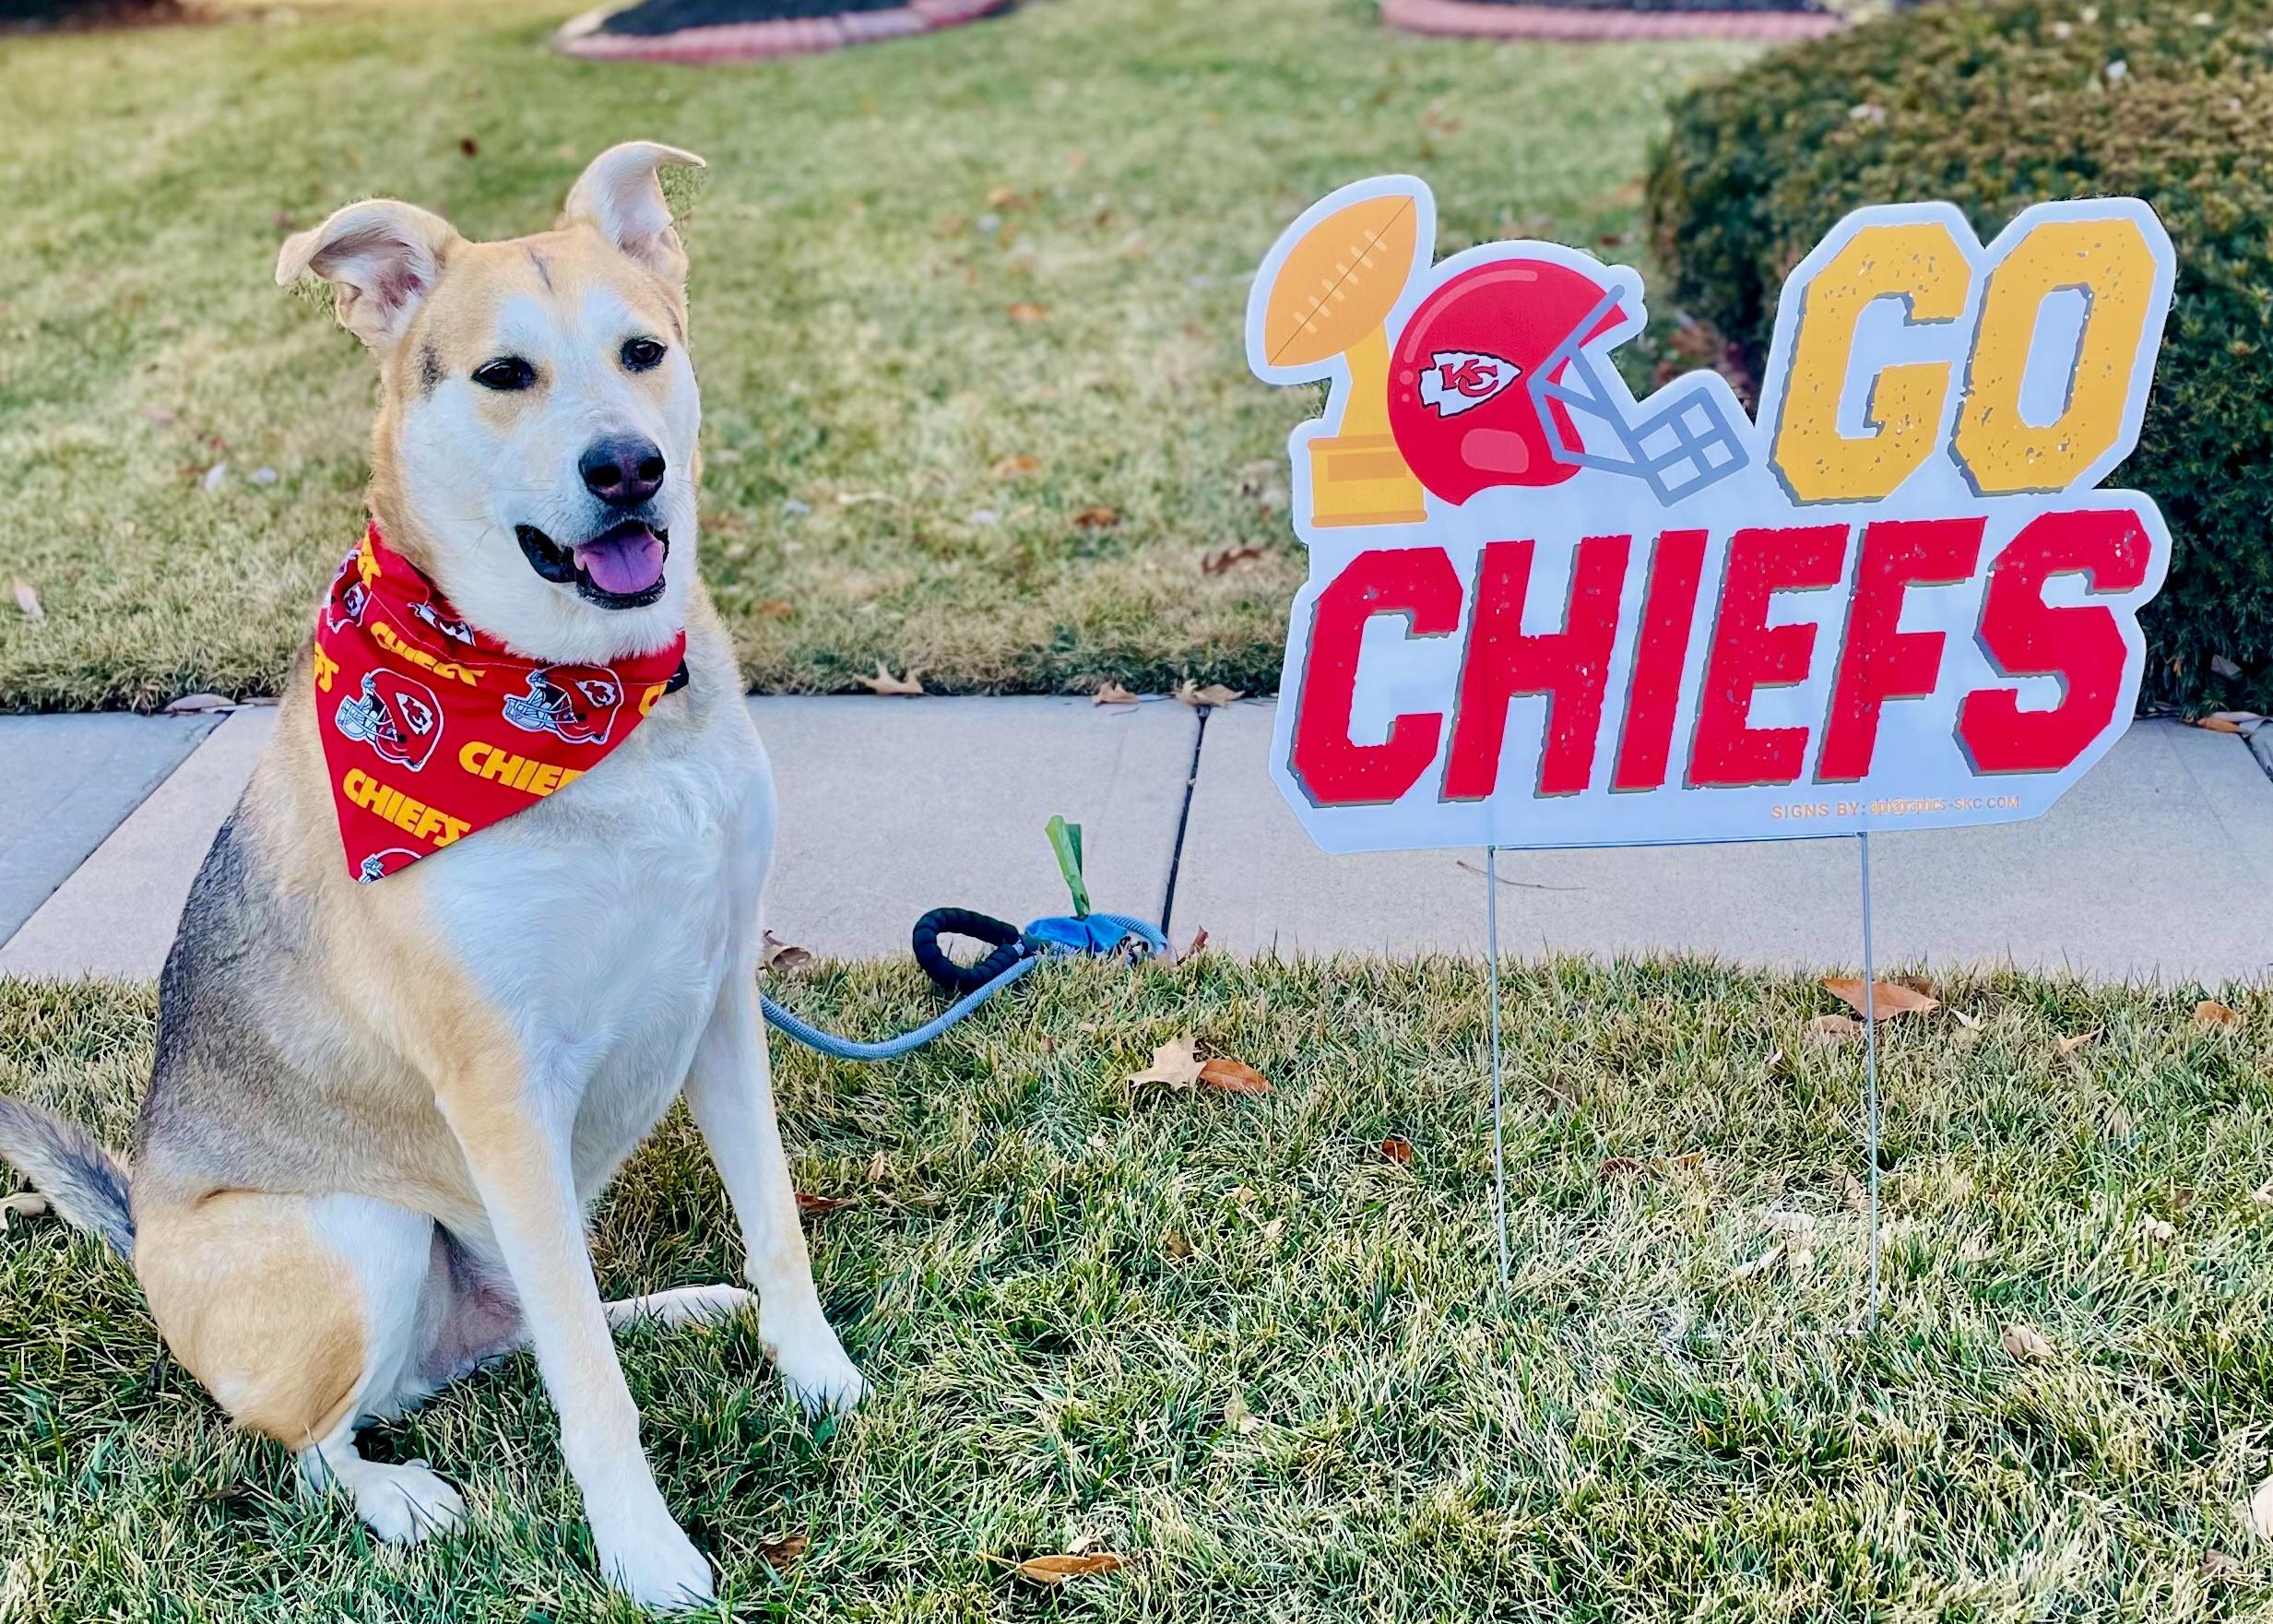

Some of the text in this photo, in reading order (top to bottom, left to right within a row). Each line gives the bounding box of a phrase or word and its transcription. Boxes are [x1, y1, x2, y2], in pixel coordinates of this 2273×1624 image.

[1438, 359, 1498, 397] KC
[1770, 221, 2154, 504] GO
[1288, 510, 2151, 807] CHIEFS
[342, 767, 472, 848] CHIEFS
[1770, 803, 1829, 819] SIGNS
[1836, 801, 1867, 817] BY:
